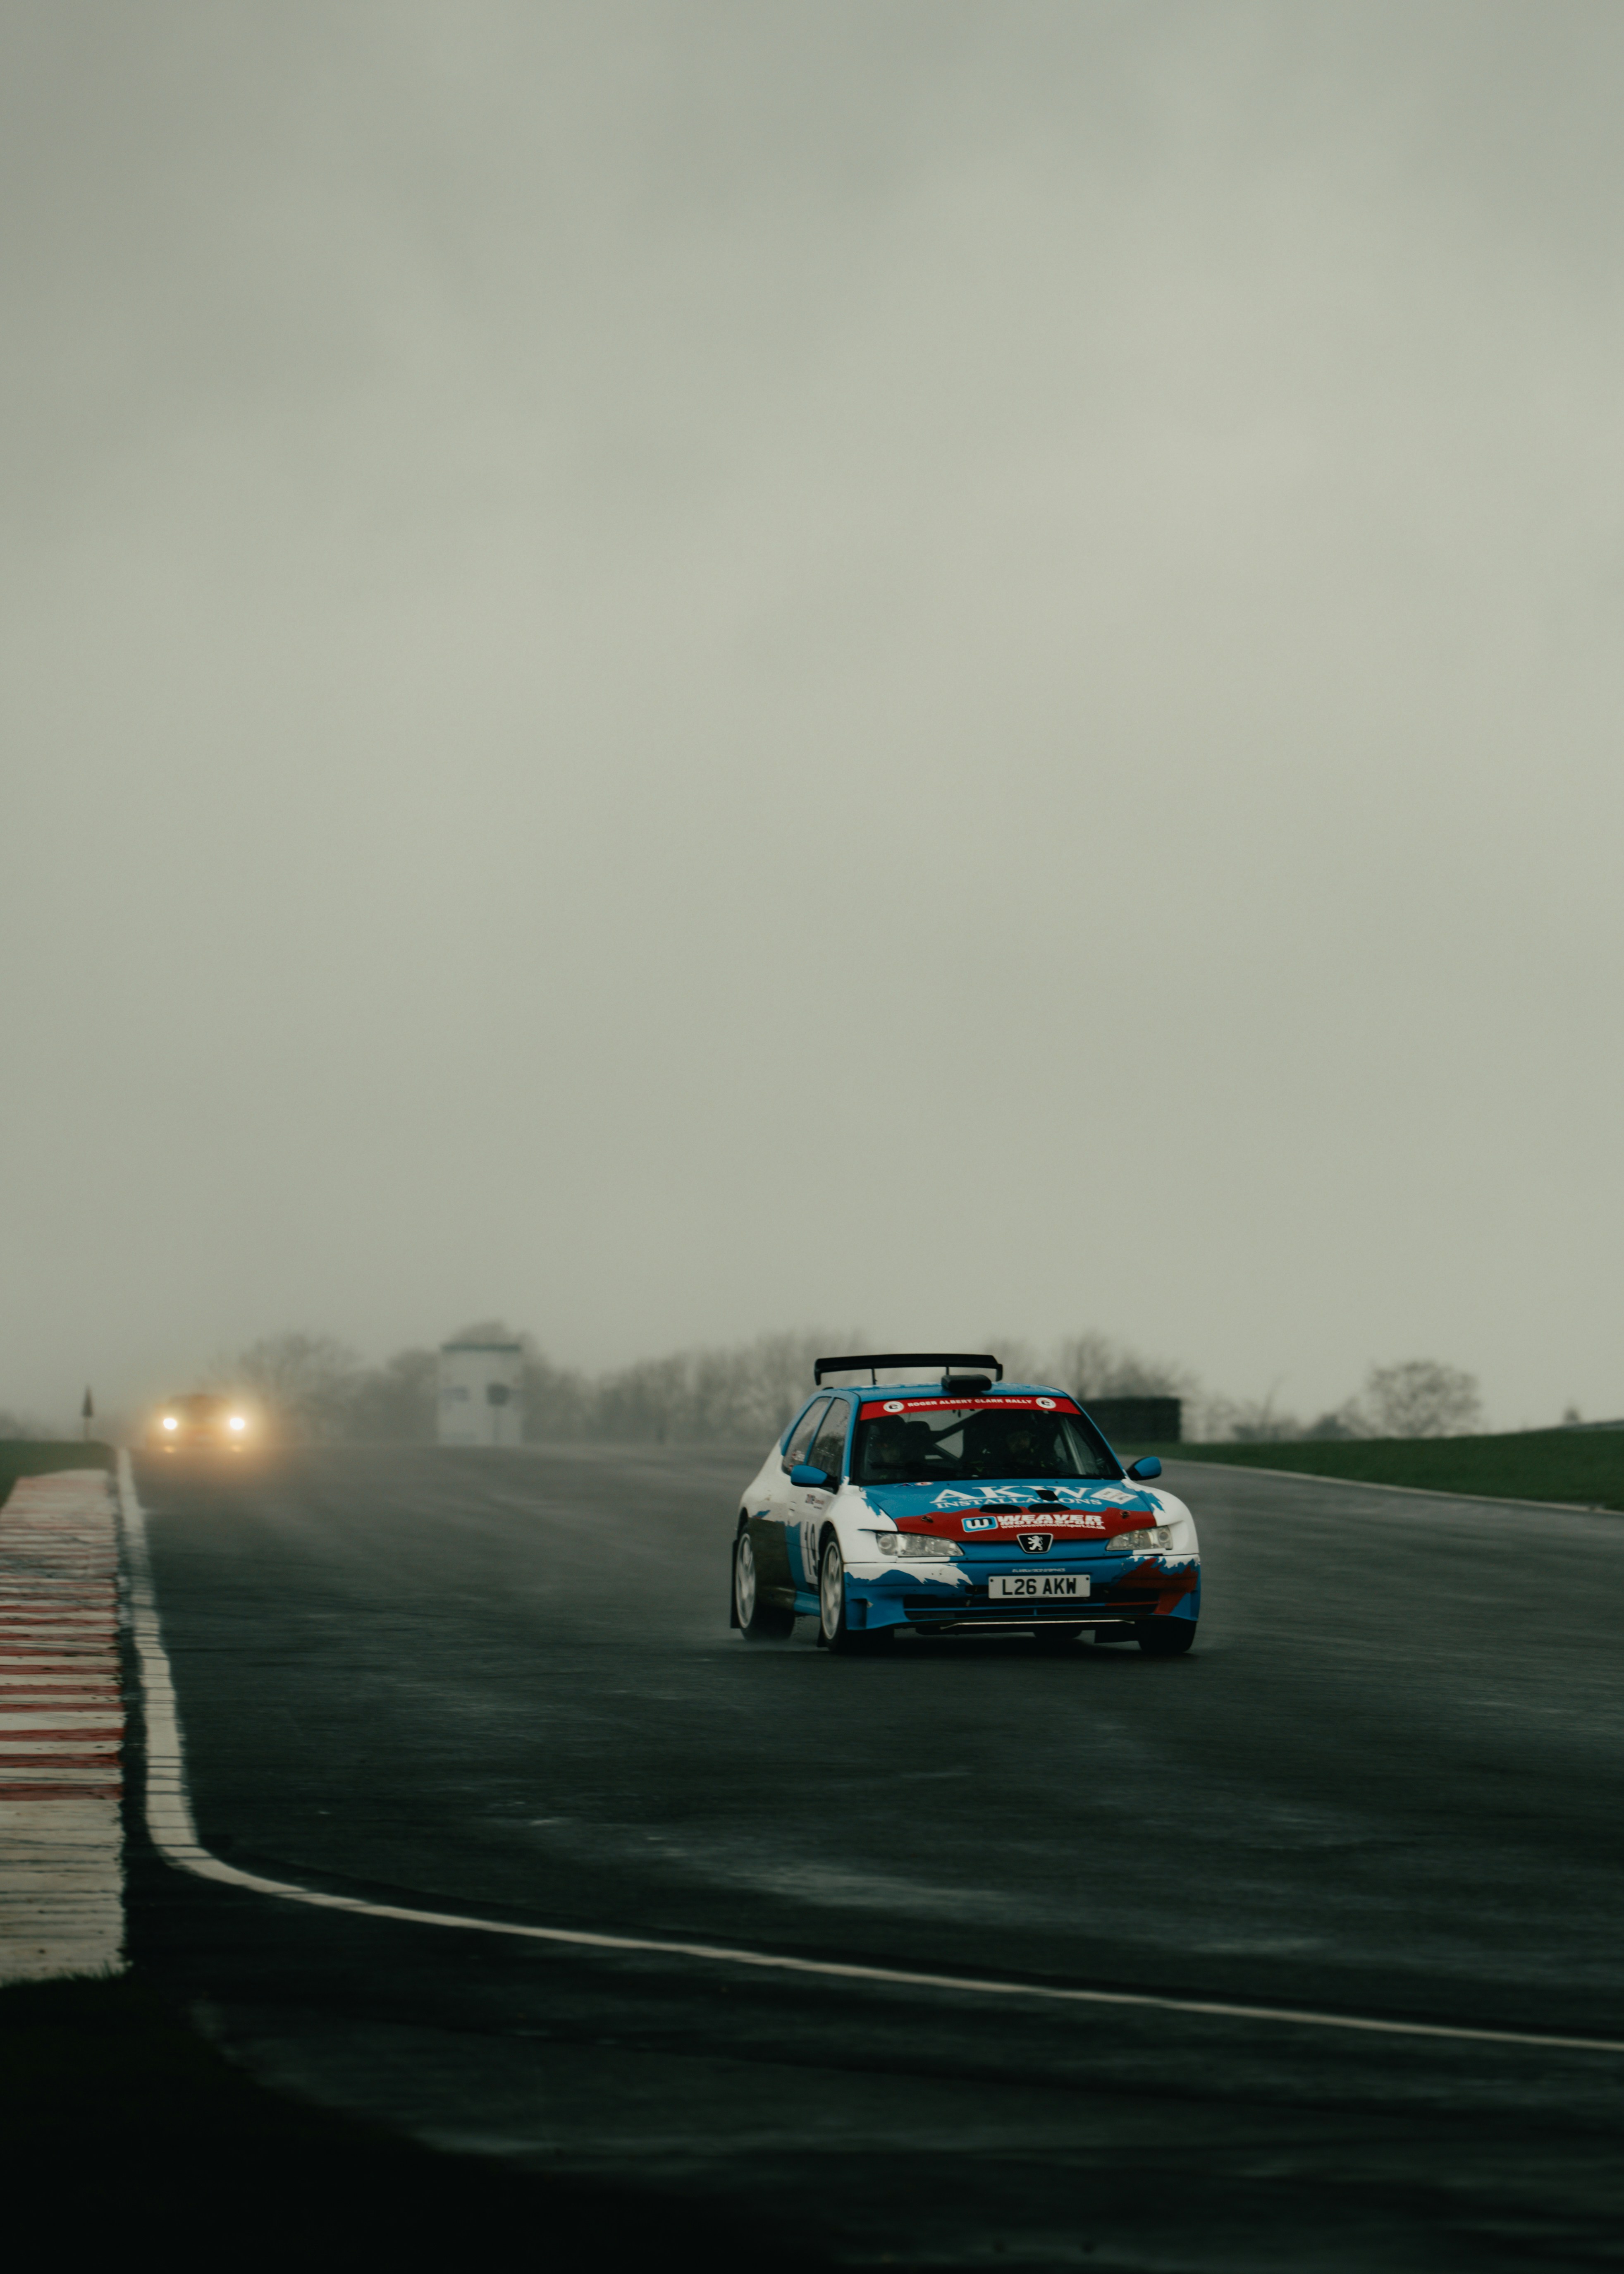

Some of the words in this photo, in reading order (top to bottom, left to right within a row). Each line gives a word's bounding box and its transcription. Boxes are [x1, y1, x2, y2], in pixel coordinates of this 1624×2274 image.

[929, 1485, 1092, 1504] AKW
[935, 1497, 1102, 1509] INSTALLAONS
[997, 1514, 1102, 1522] WEAVER
[1002, 1578, 1037, 1595] L26
[1042, 1578, 1077, 1595] AKW
